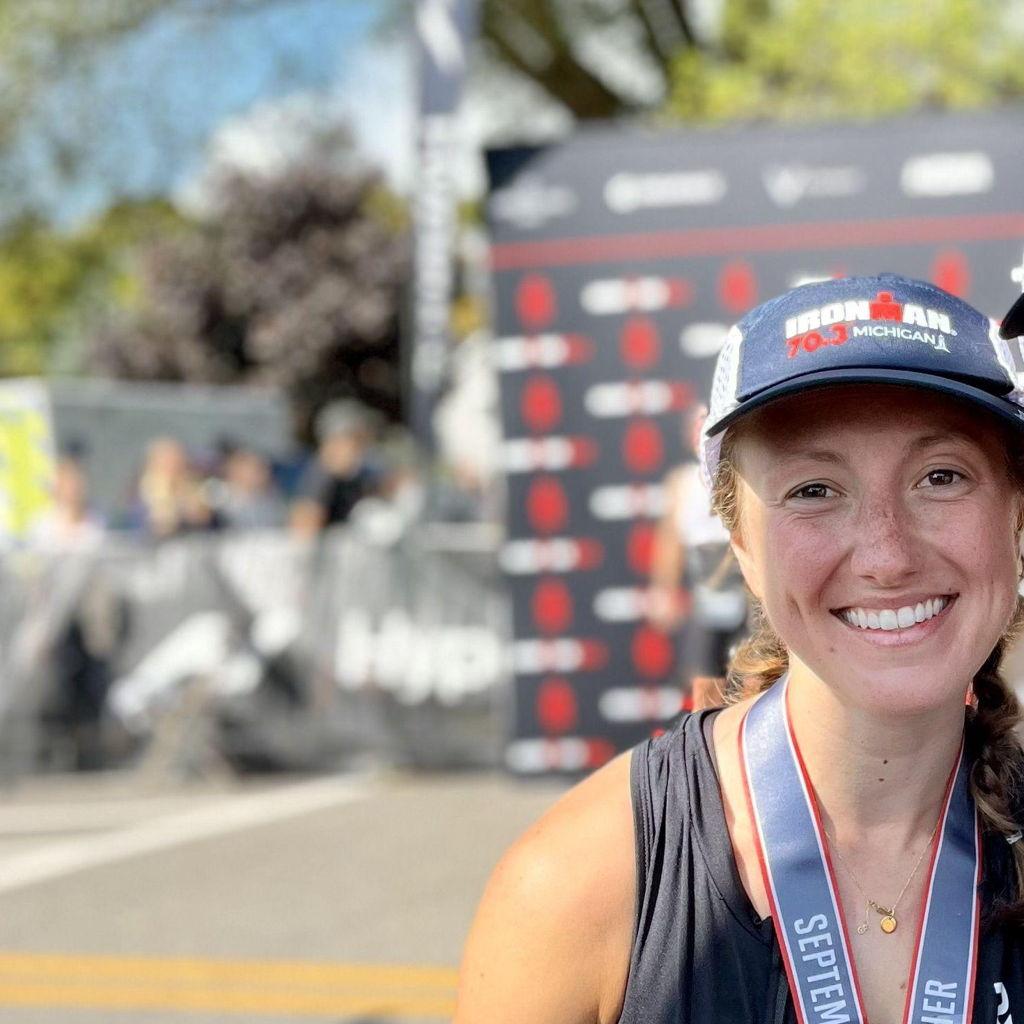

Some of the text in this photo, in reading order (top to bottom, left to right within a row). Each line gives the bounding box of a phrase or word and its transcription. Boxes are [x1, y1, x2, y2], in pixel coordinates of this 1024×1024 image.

[785, 291, 956, 338] IRONMAN
[785, 323, 936, 359] 70.3 MICHIGAN
